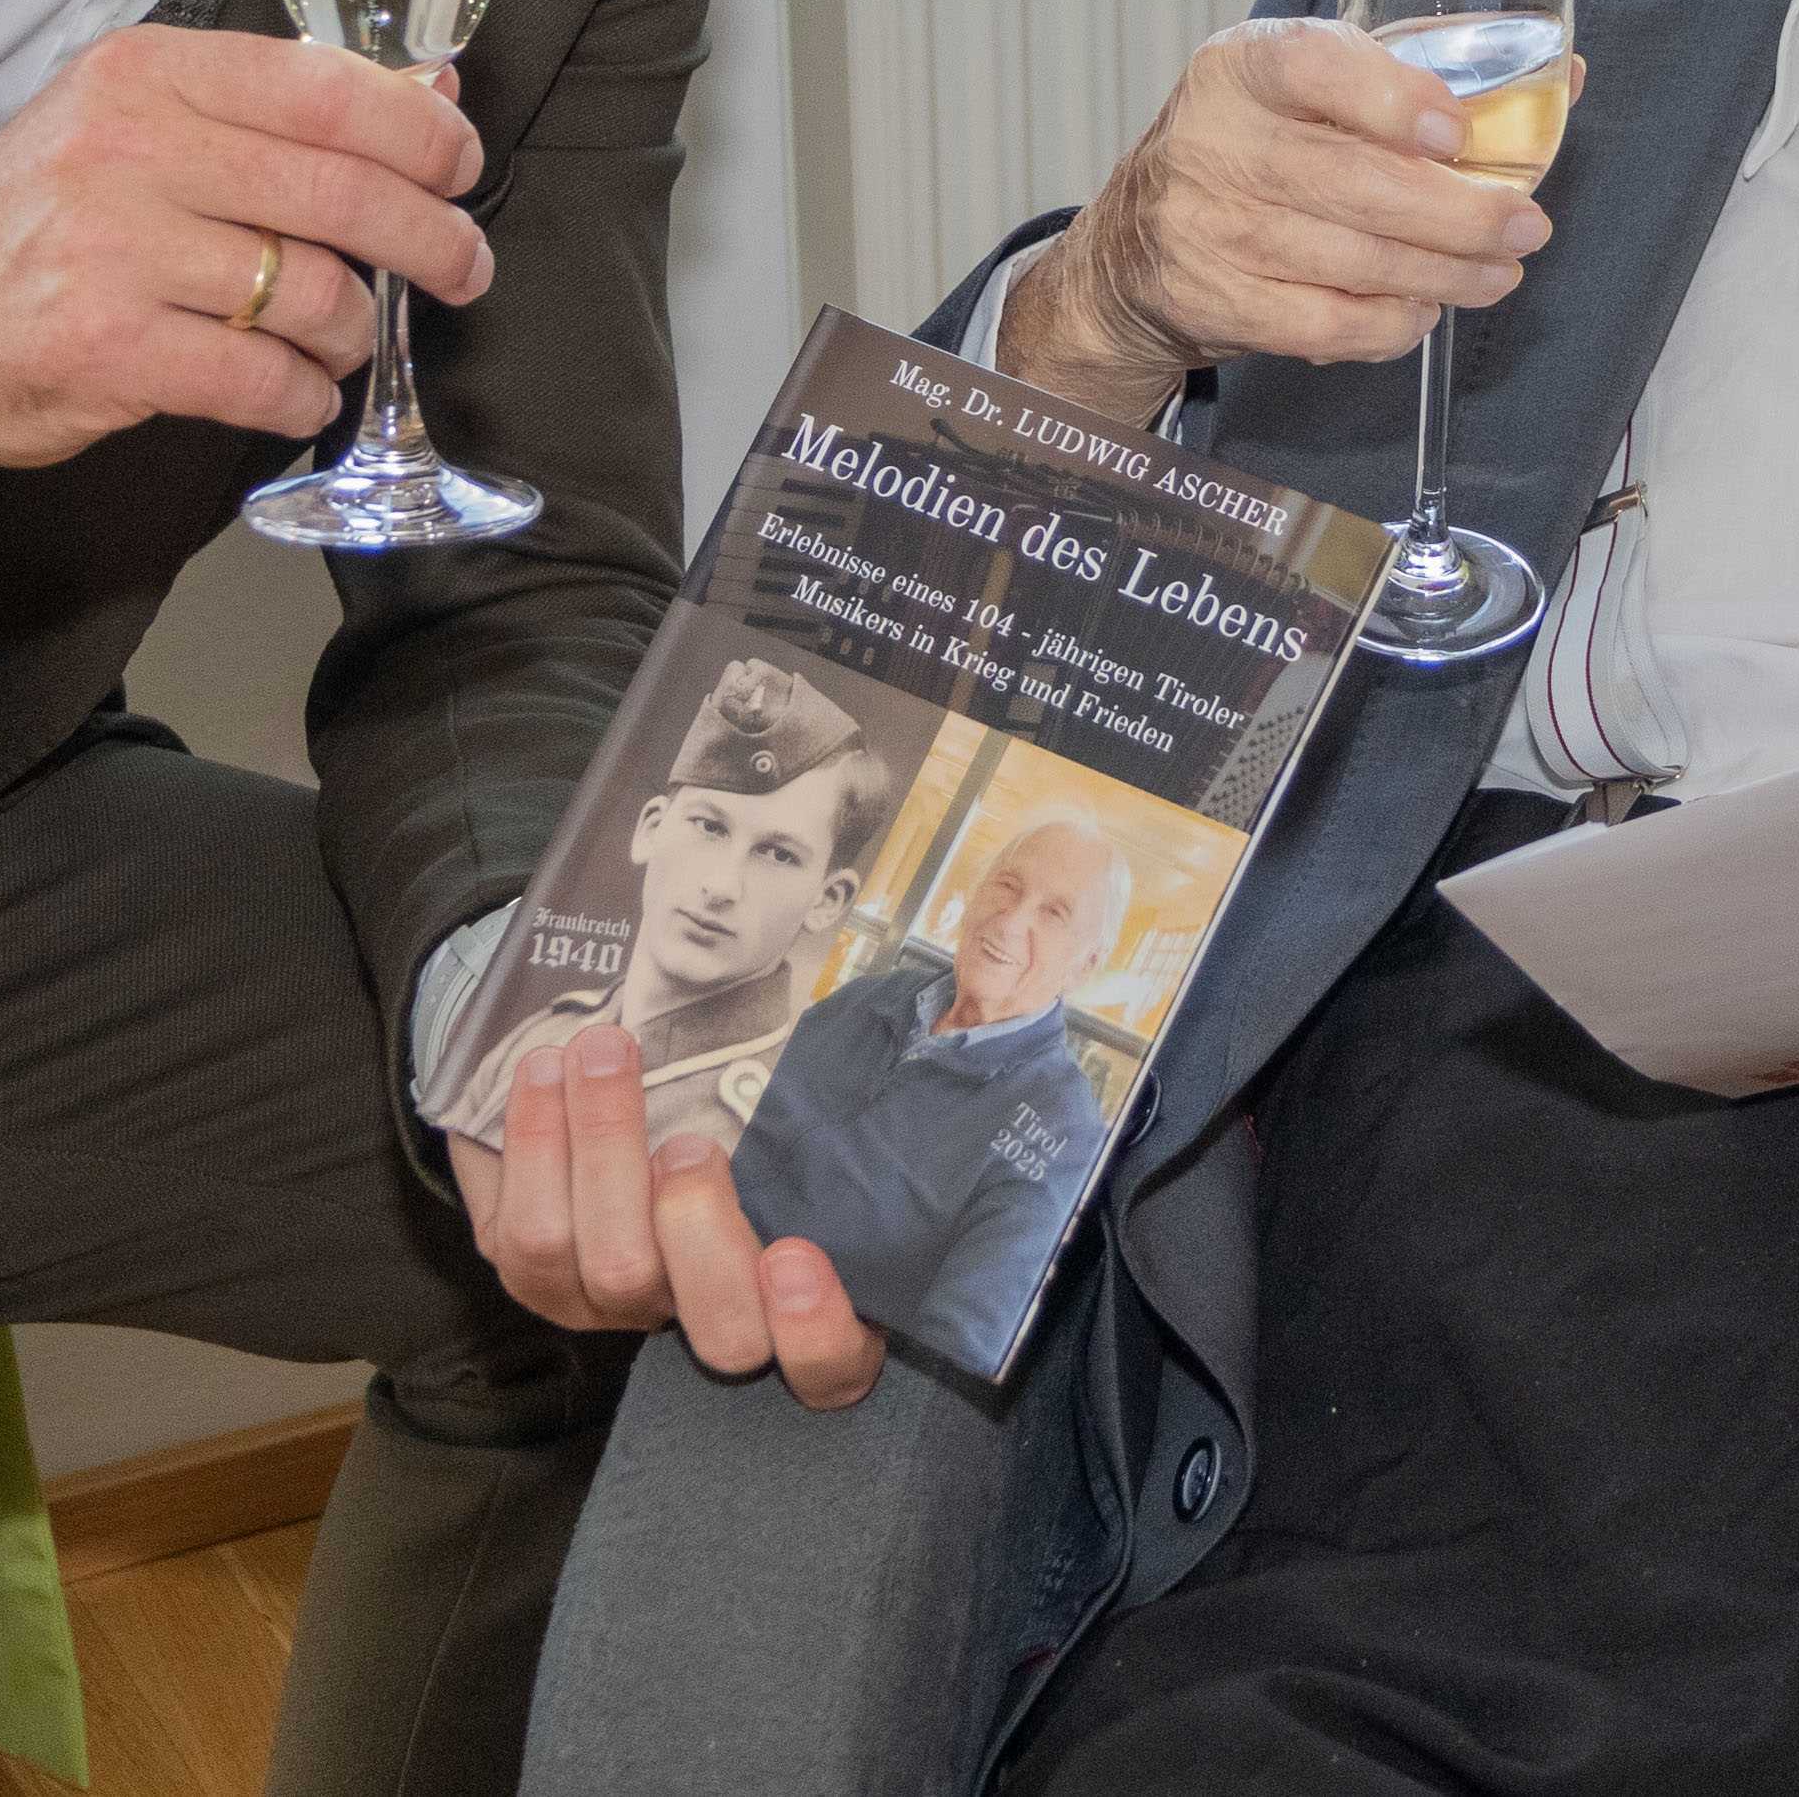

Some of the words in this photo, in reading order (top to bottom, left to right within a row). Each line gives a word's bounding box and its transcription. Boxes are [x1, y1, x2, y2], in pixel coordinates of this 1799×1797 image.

[889, 359, 952, 409] Mag.
[961, 388, 1003, 427] Dr.
[1012, 408, 1153, 481] LUDWIG
[1153, 466, 1291, 537] ASCHER
[757, 512, 886, 584] Erlebnisse
[891, 573, 957, 614] eines
[961, 598, 1015, 637] 104
[1031, 628, 1144, 691] jährigen
[1153, 672, 1245, 730] Tiroler
[781, 413, 1006, 543] Melodien
[1020, 512, 1107, 581] des
[1117, 547, 1307, 662] Lebens
[790, 574, 905, 642] Musikers
[909, 624, 936, 655] in
[940, 635, 1016, 692] Krieg
[1019, 676, 1072, 709] und
[1072, 690, 1174, 753] Frieden
[527, 932, 624, 974] 1940
[990, 1128, 1047, 1182] 2025
[1013, 1101, 1069, 1158] Tirol
